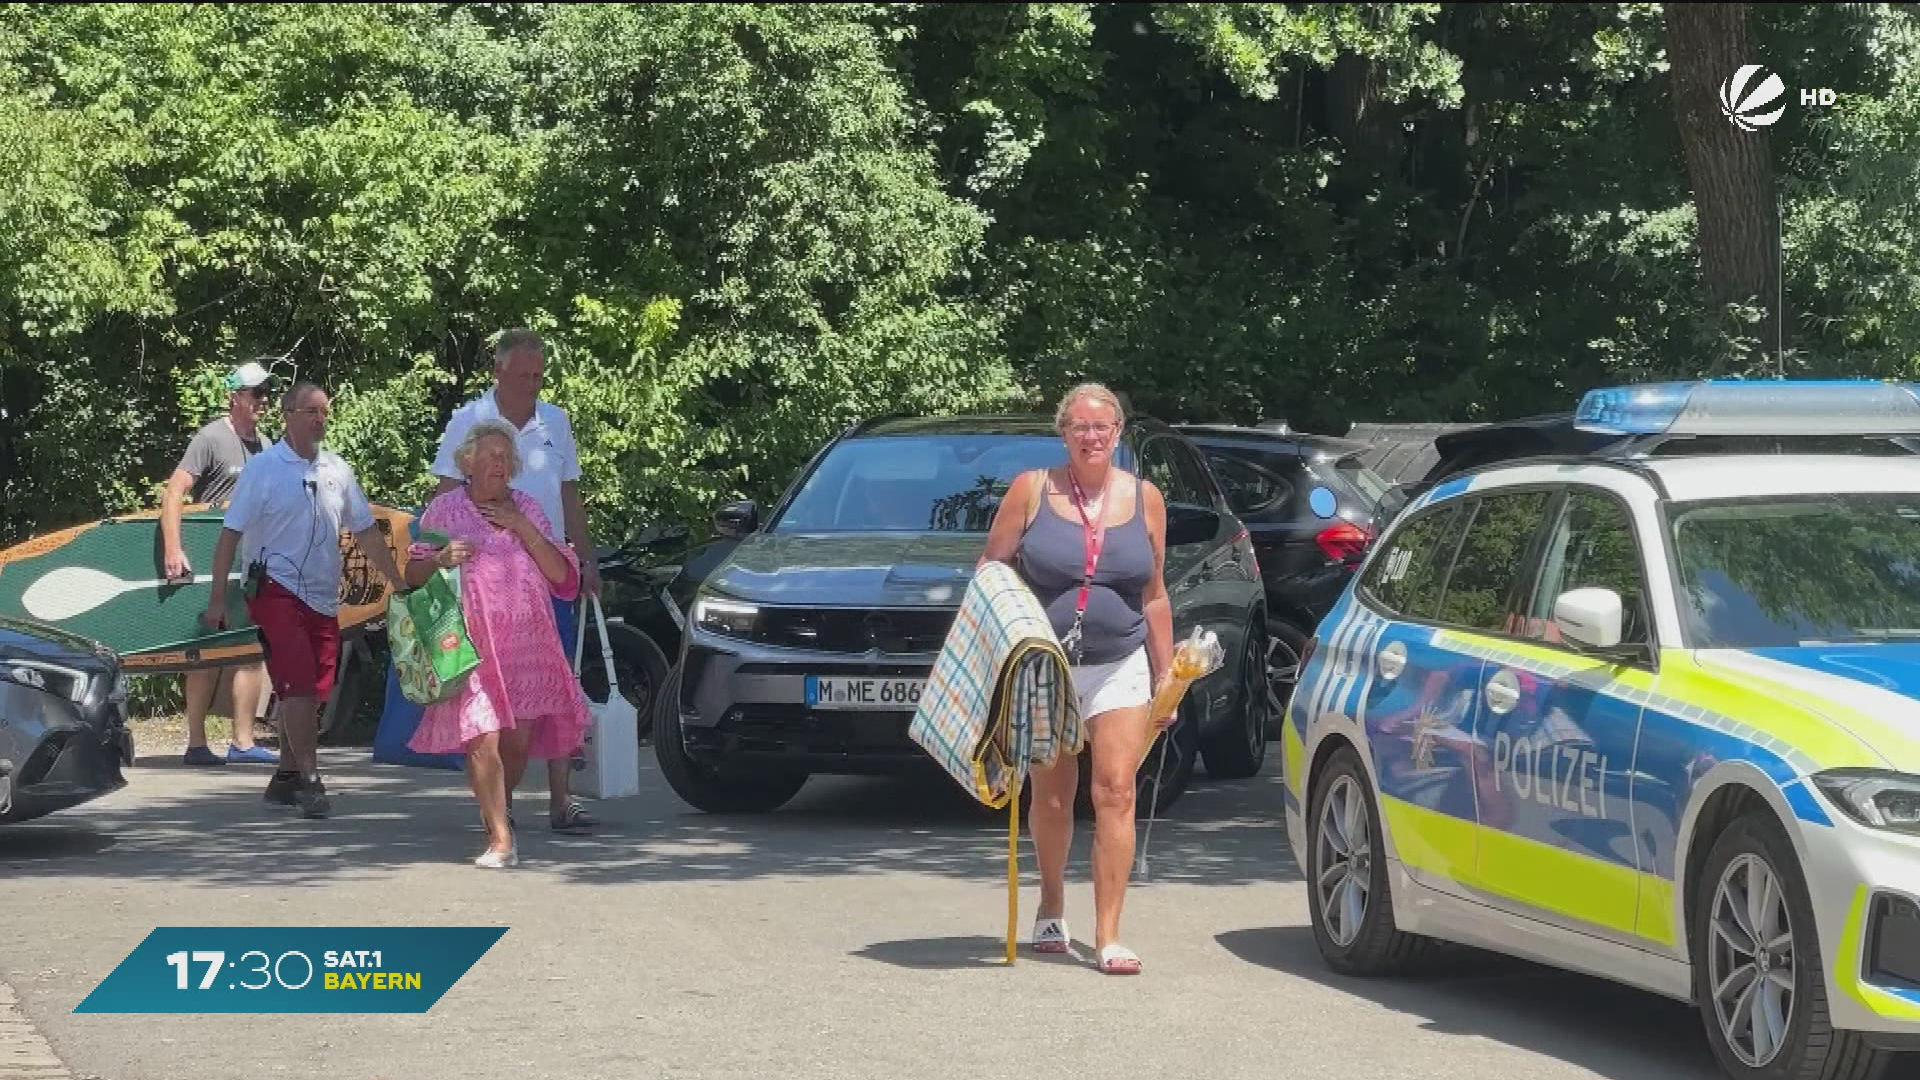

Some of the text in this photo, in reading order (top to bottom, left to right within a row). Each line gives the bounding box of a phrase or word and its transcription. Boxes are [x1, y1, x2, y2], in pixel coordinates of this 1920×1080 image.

[819, 680, 927, 704] M ME 686
[1494, 730, 1608, 820] POLIZEI
